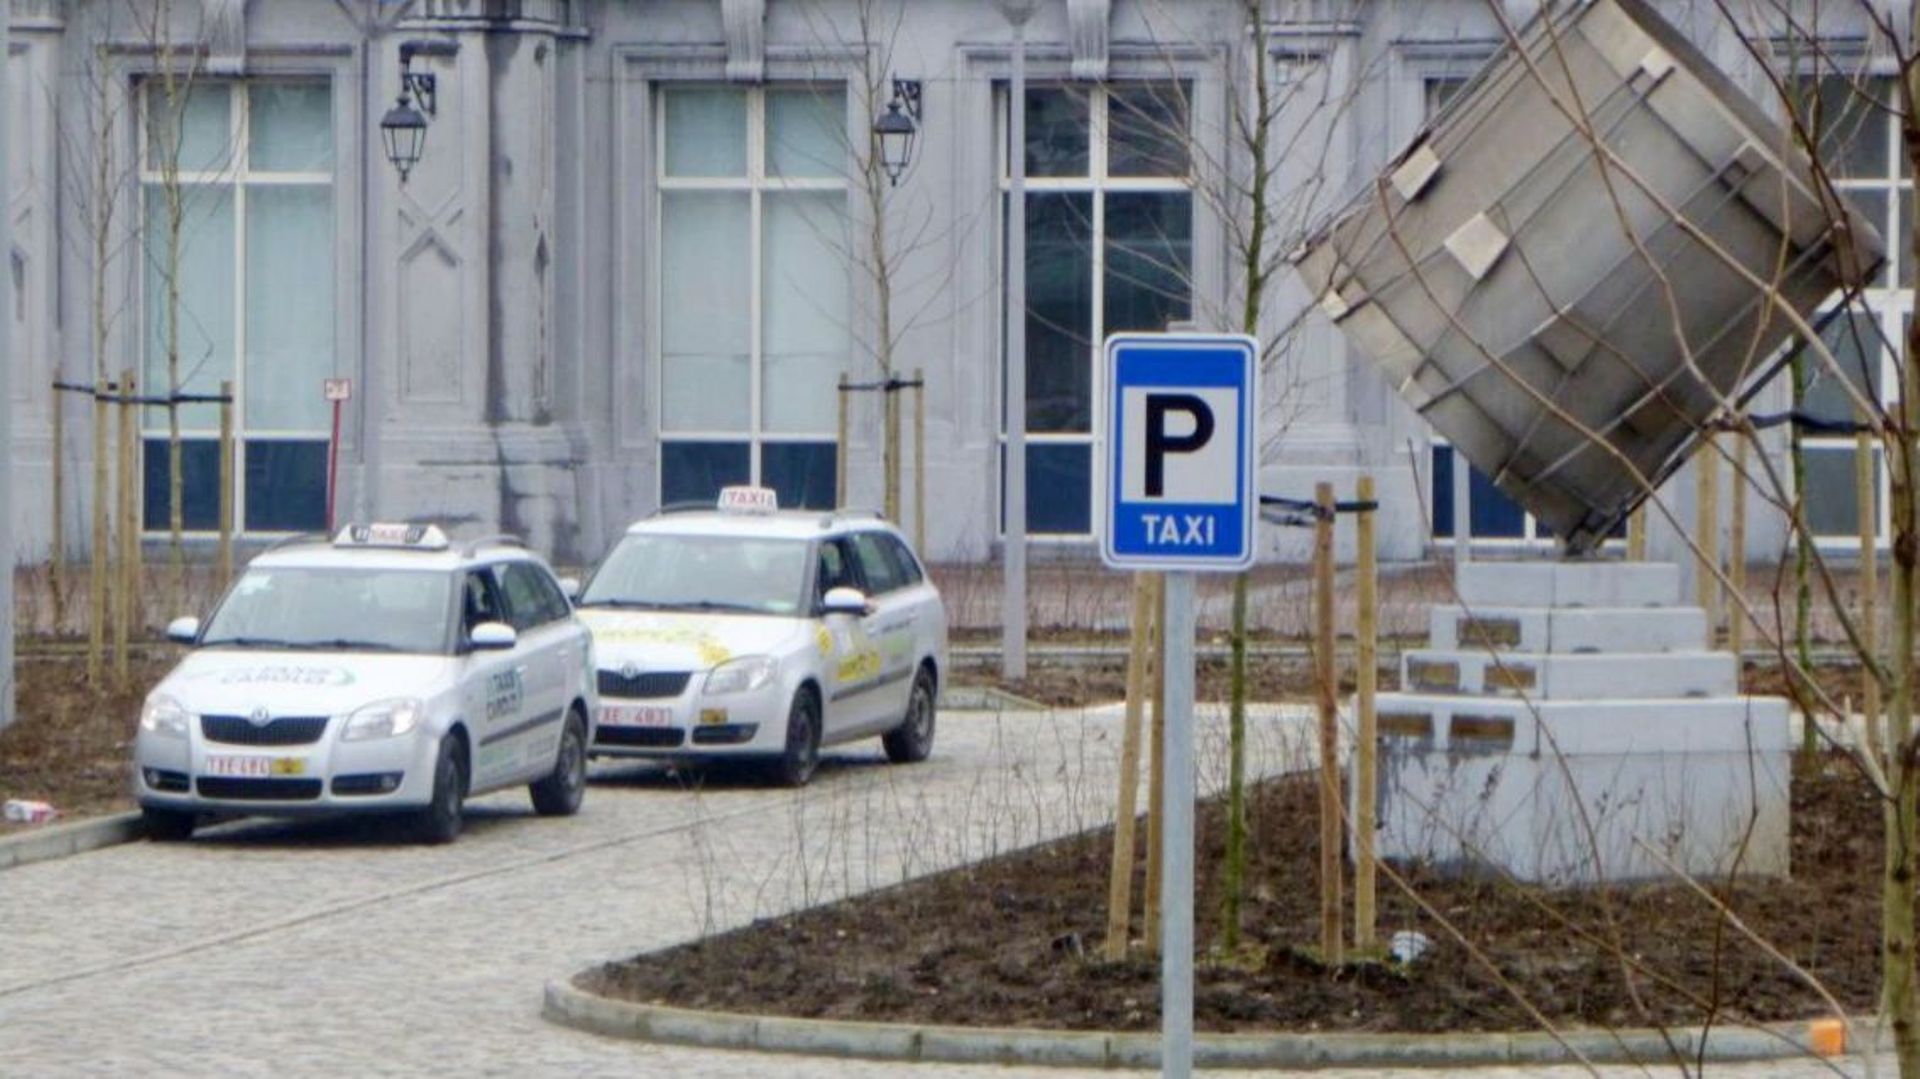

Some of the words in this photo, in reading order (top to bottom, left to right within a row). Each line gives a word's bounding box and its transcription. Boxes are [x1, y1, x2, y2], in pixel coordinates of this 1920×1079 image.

[1145, 393, 1214, 497] P
[729, 490, 766, 504] TAXI
[1141, 514, 1215, 545] TAXI
